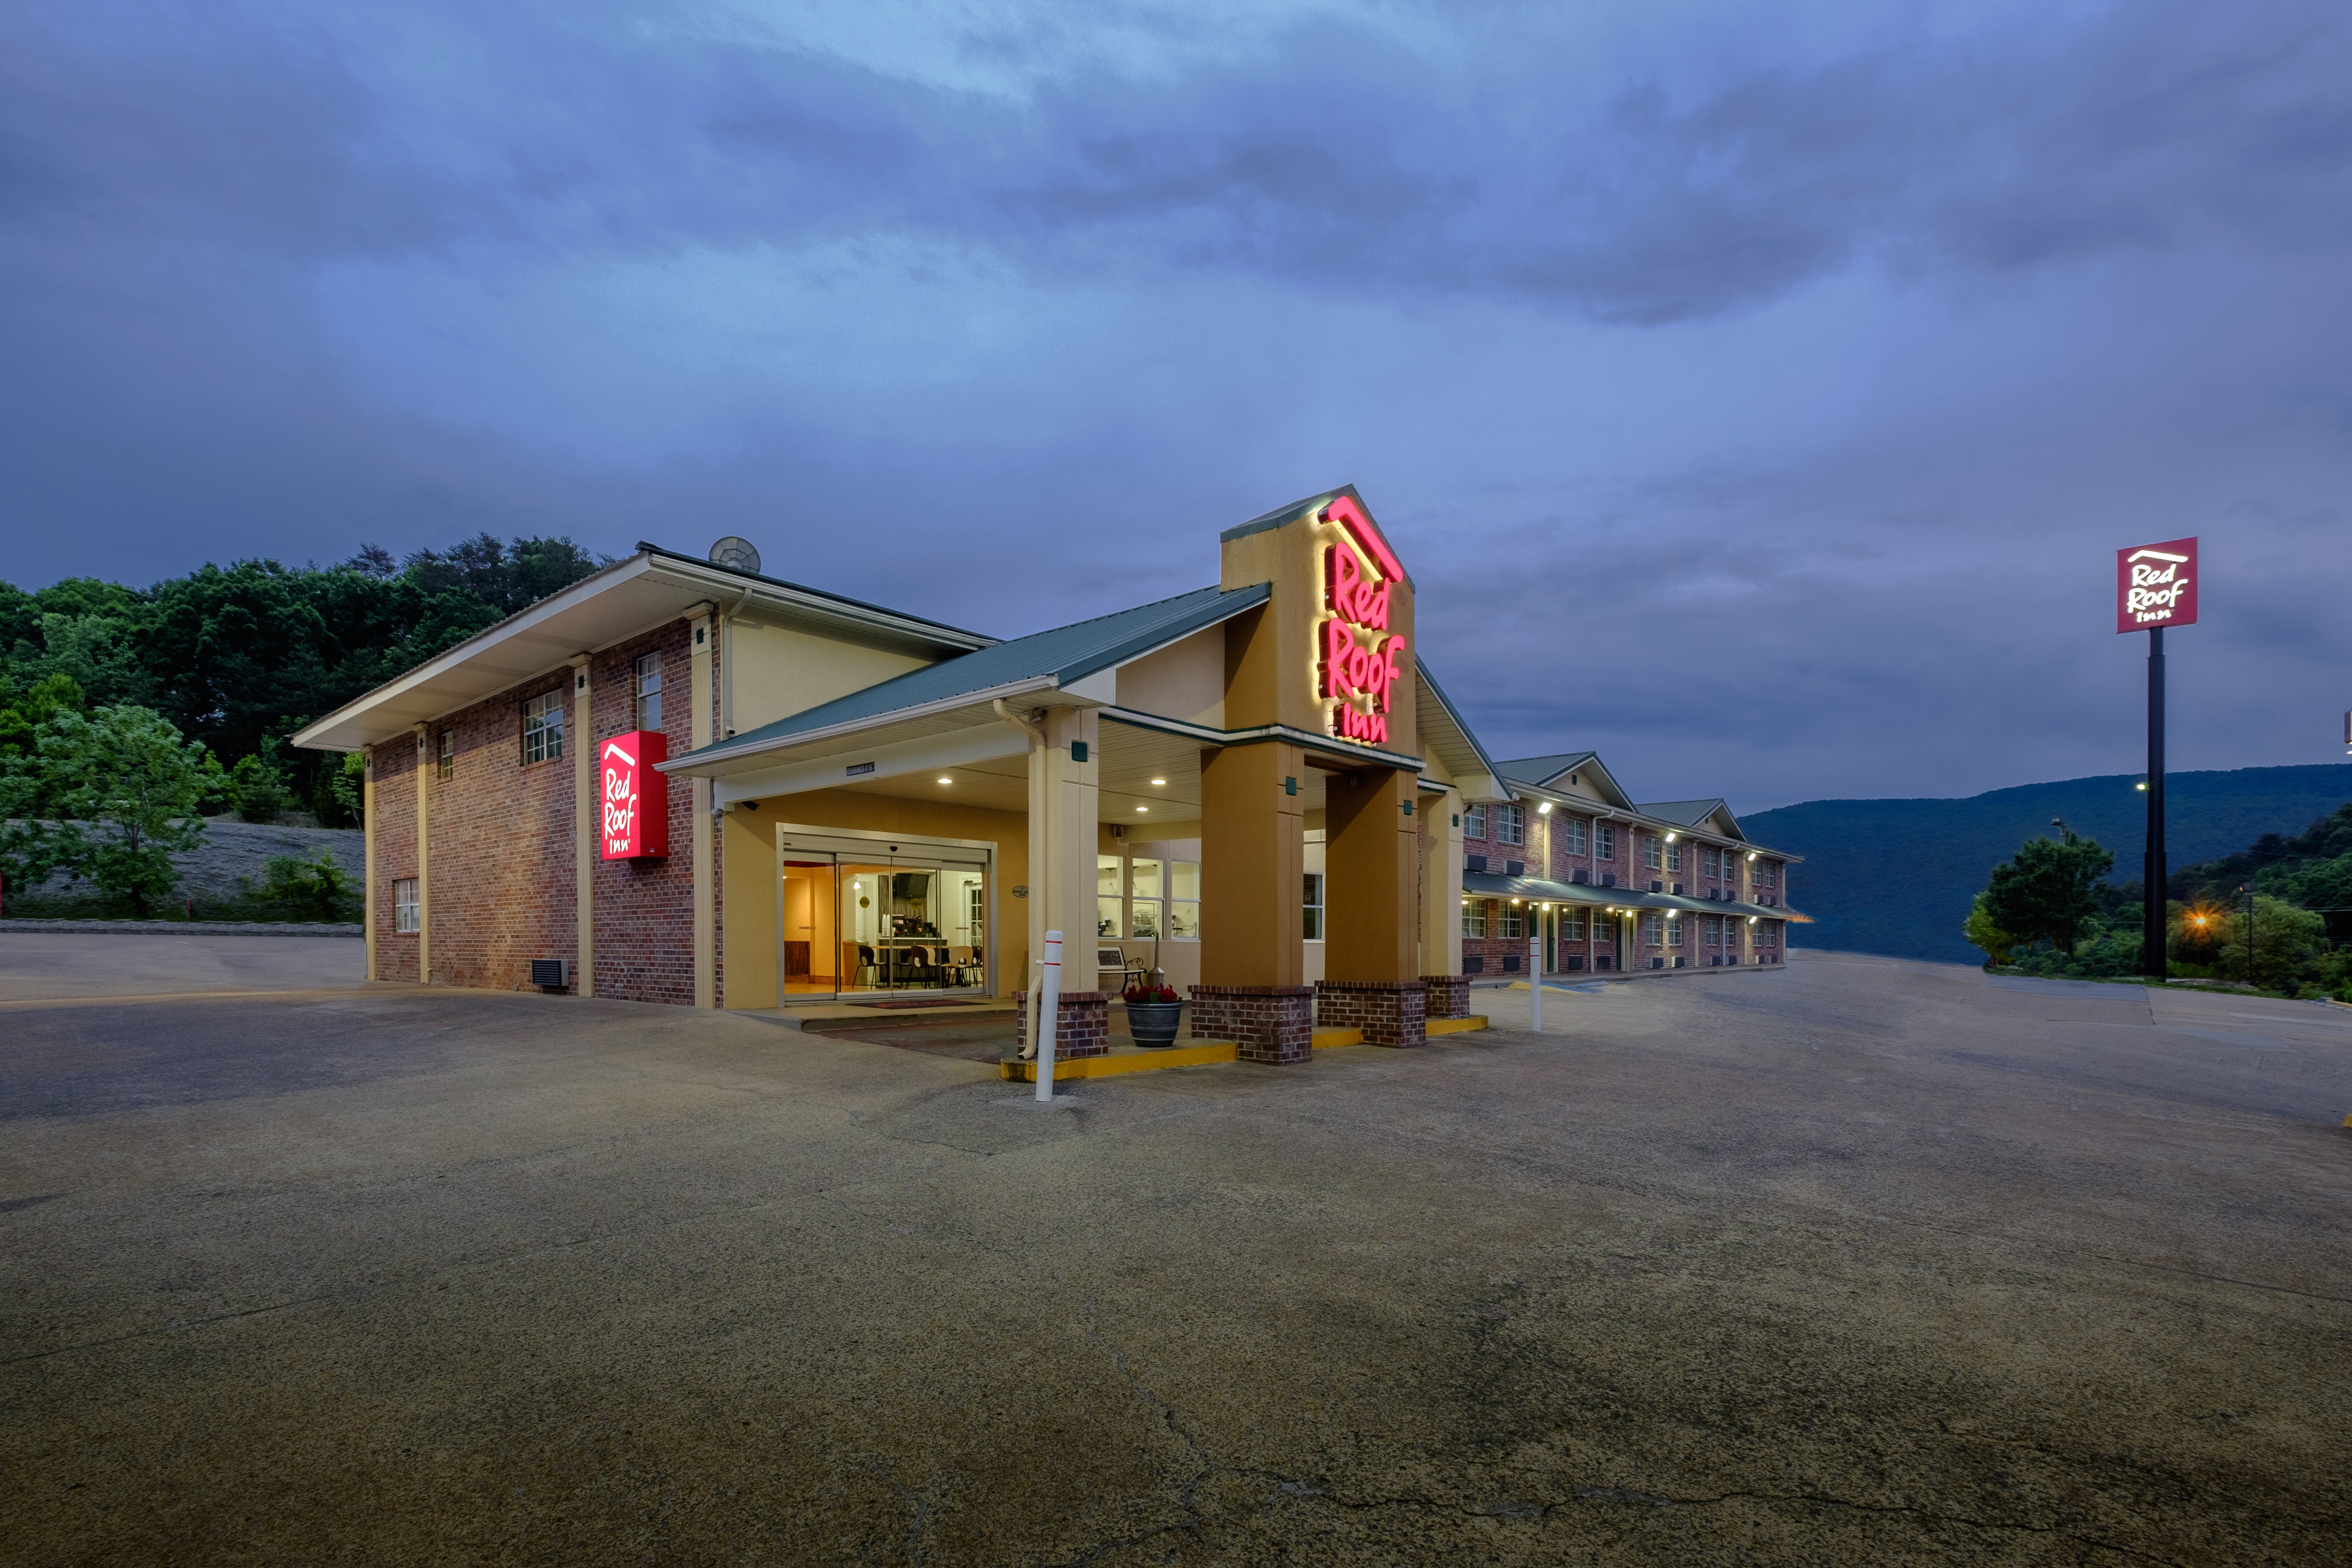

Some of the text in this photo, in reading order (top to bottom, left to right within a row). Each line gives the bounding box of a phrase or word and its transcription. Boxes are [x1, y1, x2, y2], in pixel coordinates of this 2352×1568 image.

[1335, 542, 1390, 630] Red
[2132, 563, 2176, 586] Red
[2127, 579, 2189, 613] Roof
[1328, 618, 1405, 713] Roof
[1344, 702, 1387, 743] Inn
[606, 768, 630, 802] Red
[605, 793, 637, 840] Roof
